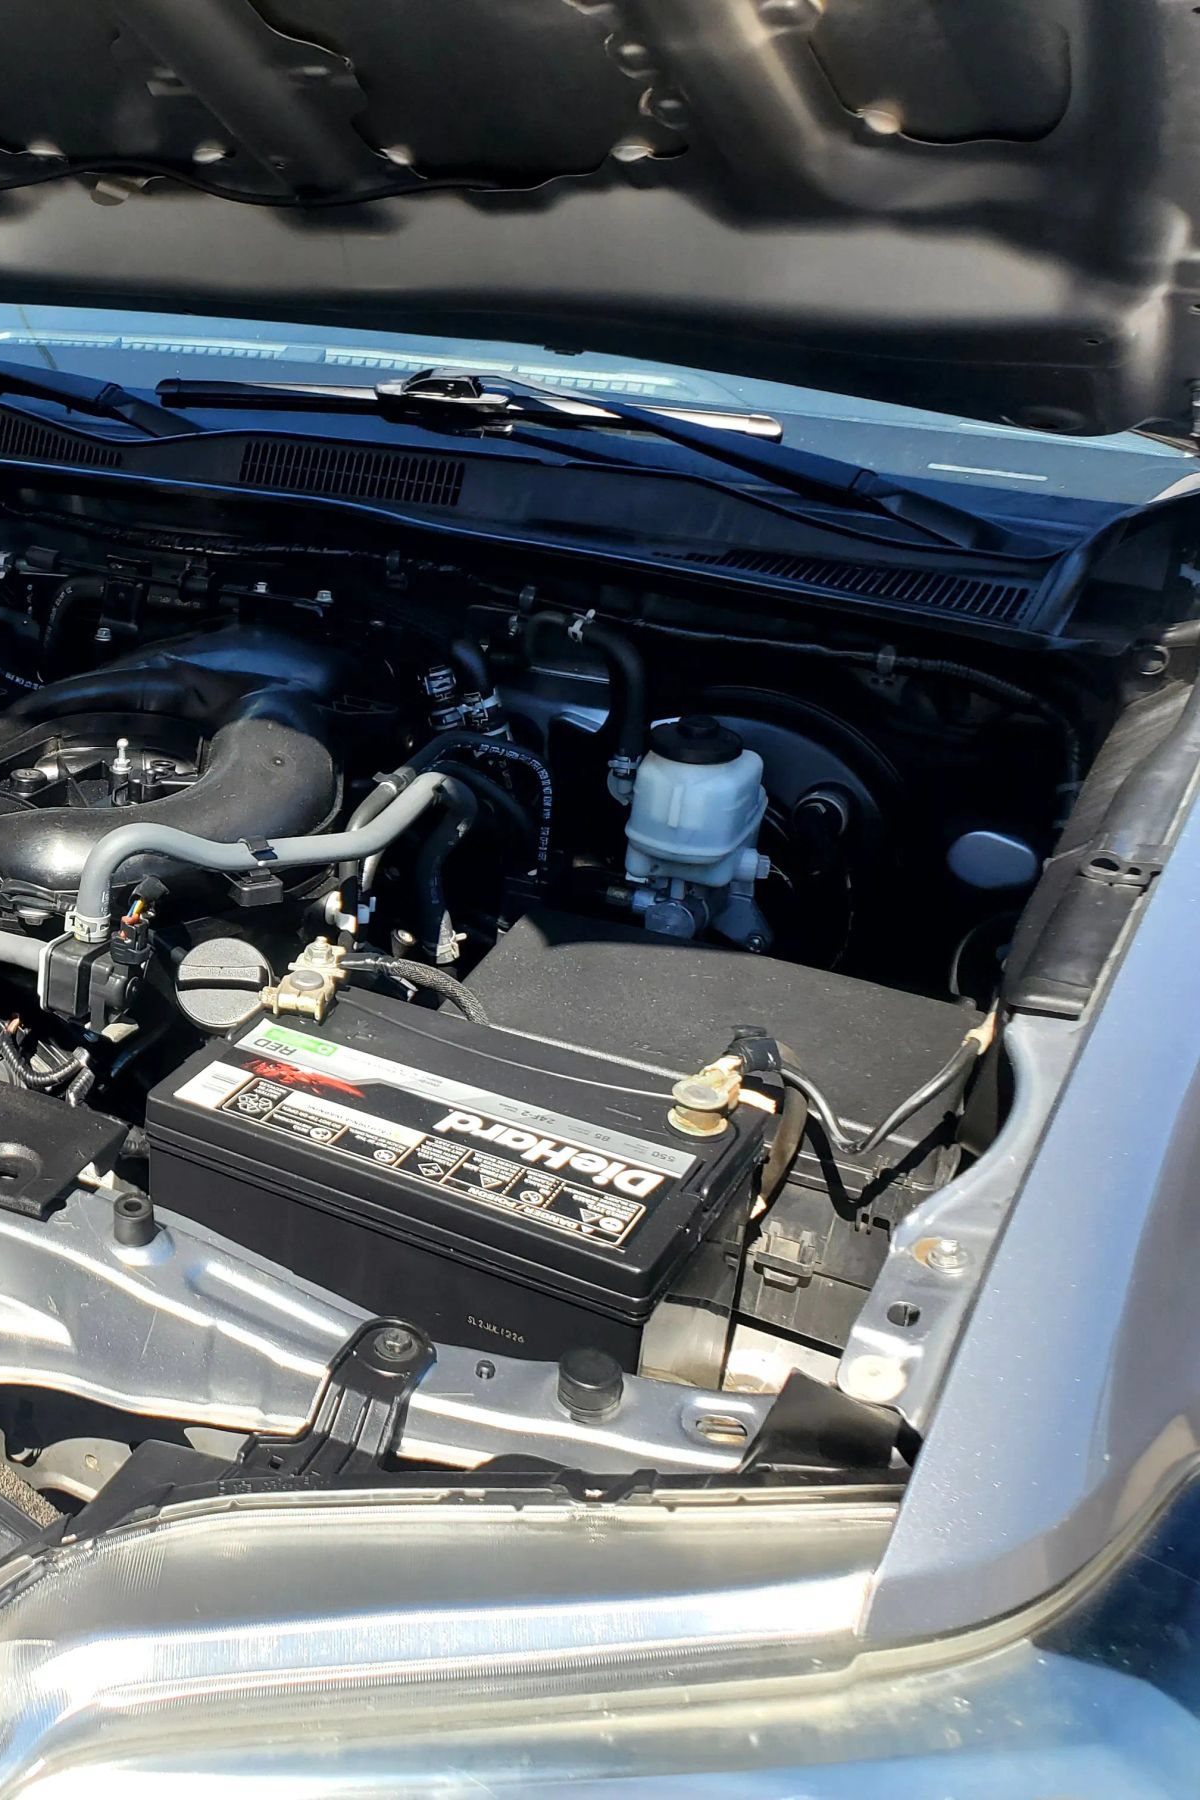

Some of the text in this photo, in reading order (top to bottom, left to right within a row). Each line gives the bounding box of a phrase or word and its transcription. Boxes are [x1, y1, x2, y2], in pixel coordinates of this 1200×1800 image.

[252, 1037, 296, 1056] RED
[519, 1109, 556, 1124] 24F-2
[428, 1107, 666, 1198] DieHard
[650, 1150, 677, 1162] 550
[465, 1186, 518, 1207] POISON
[522, 1205, 580, 1228] DANGER
